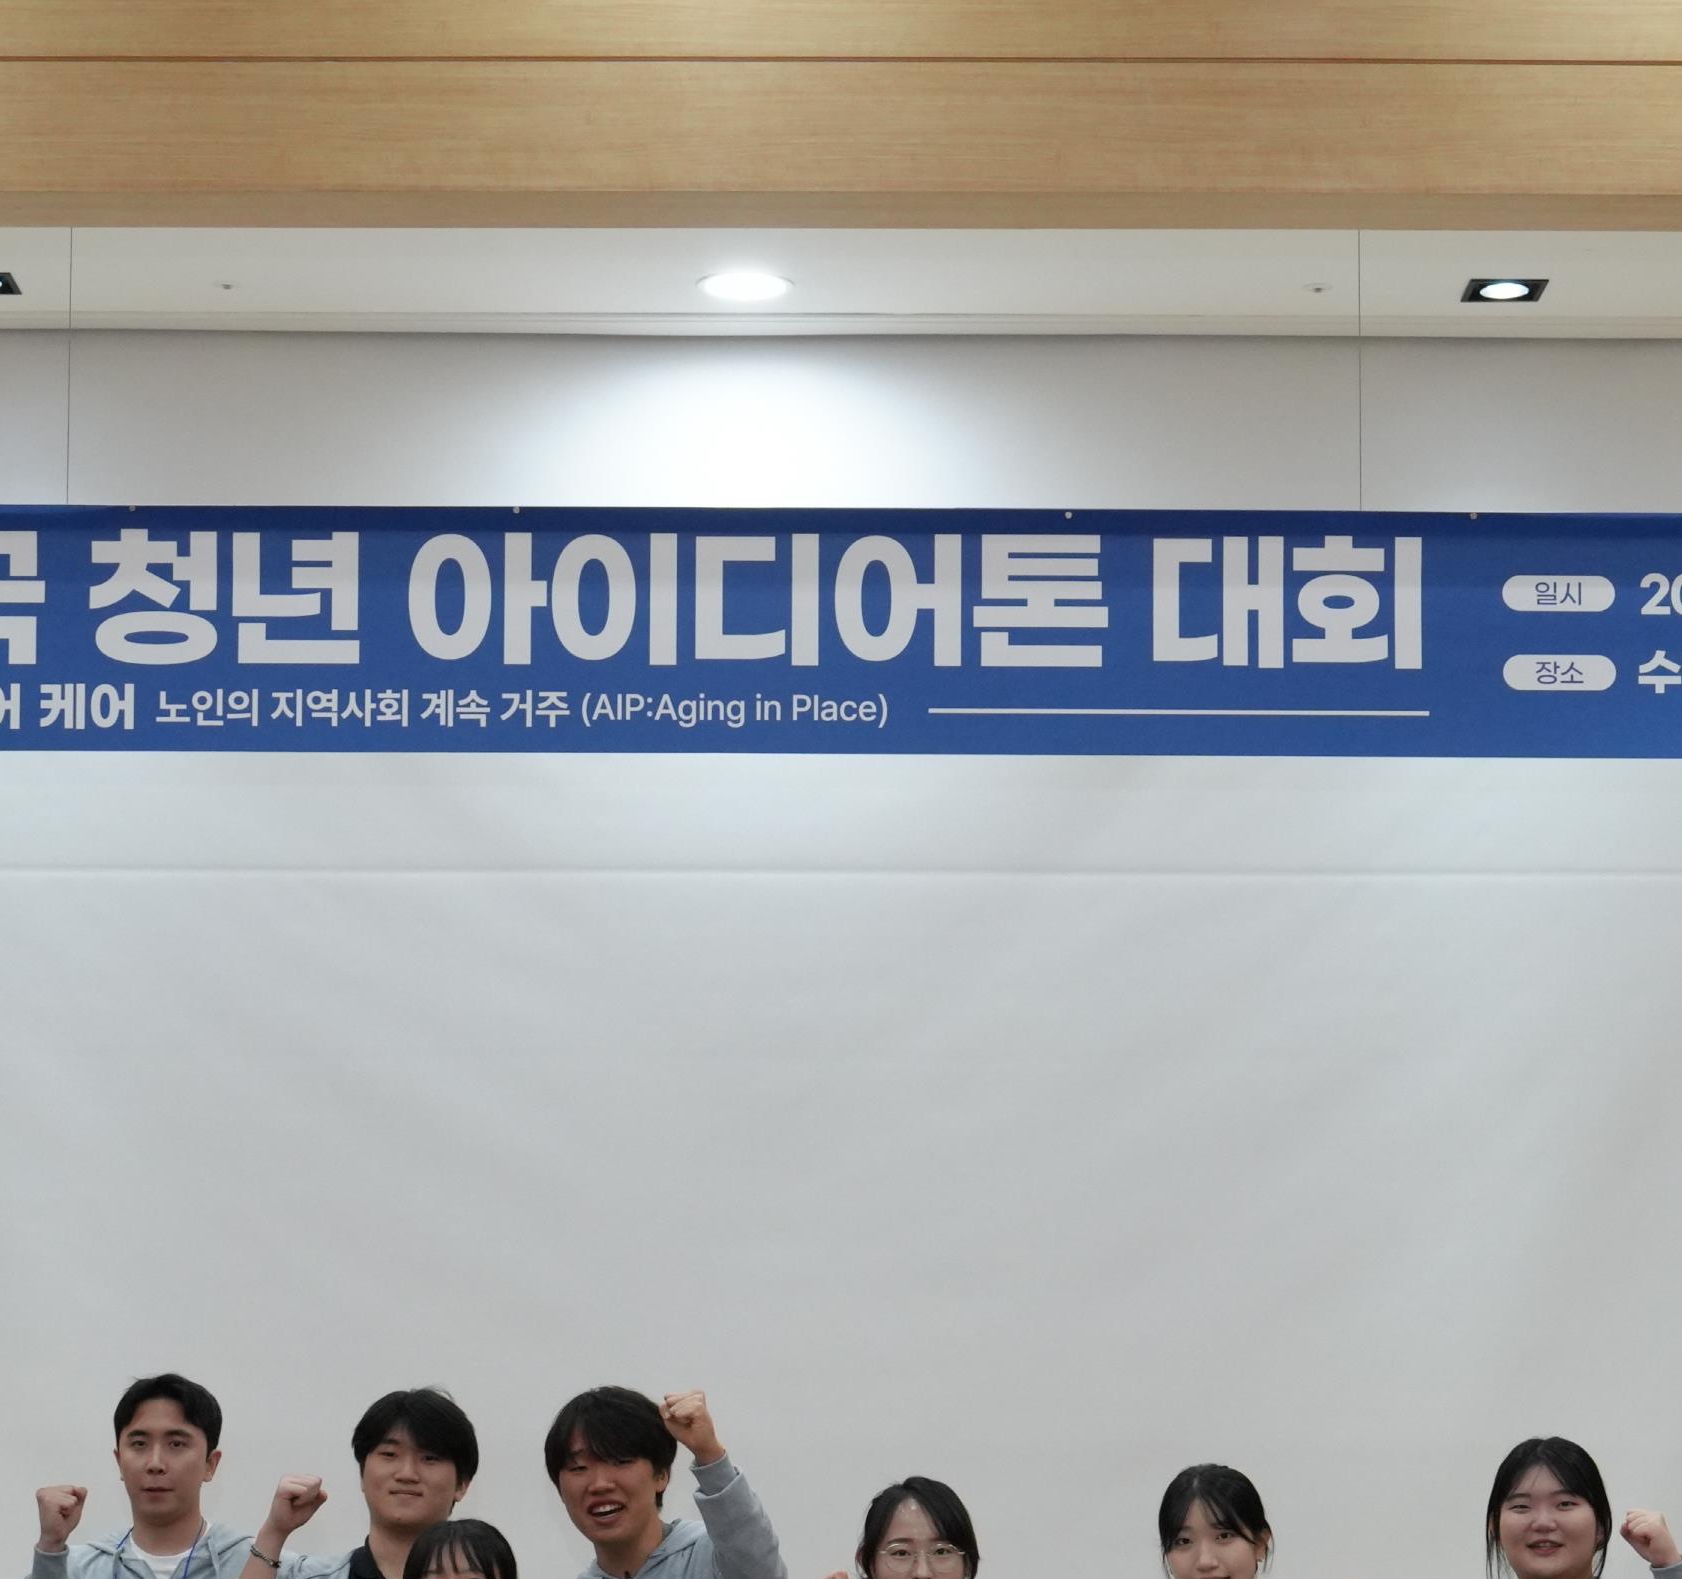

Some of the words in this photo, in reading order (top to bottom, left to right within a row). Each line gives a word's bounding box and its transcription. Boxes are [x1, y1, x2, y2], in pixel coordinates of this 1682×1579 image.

[89, 529, 360, 664] 청년
[408, 531, 1108, 666] 아이디어톤
[1152, 535, 1422, 669] 대회
[1534, 581, 1582, 607] 일시
[1534, 660, 1584, 686] 장소
[40, 683, 135, 730] 케어
[155, 689, 259, 727] 노인의
[270, 689, 409, 728] 지역사회
[421, 689, 490, 728] 계속
[500, 690, 570, 728] 거주
[581, 692, 745, 729] (AIP:Aging
[755, 693, 781, 721] in
[792, 692, 888, 728] Place)
